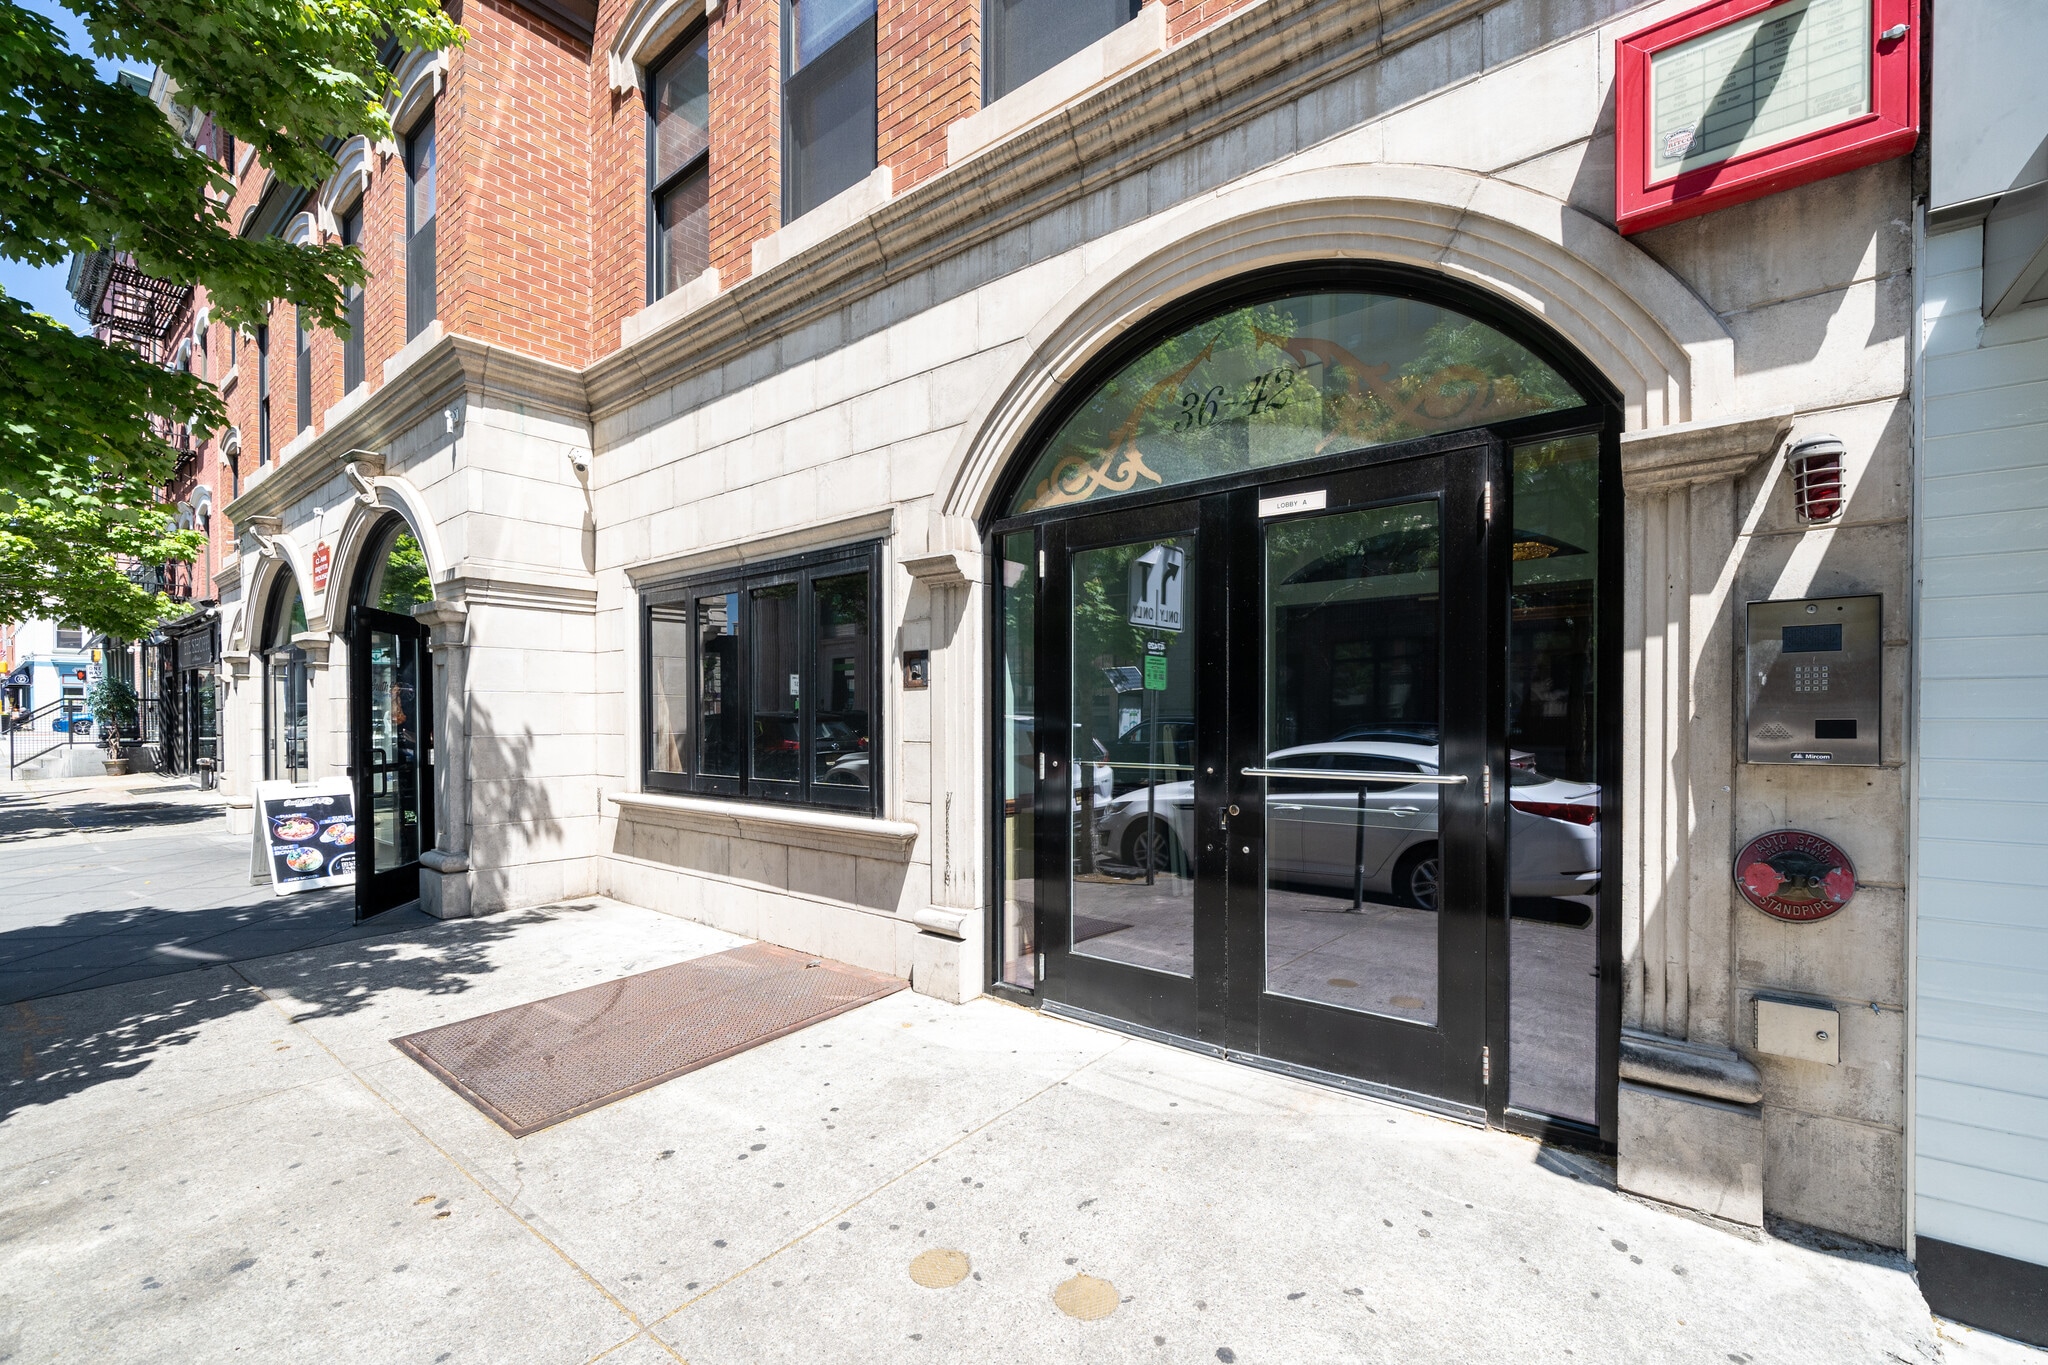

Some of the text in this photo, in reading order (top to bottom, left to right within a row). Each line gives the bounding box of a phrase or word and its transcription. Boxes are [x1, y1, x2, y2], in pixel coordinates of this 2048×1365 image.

[1173, 366, 1295, 433] 36-42
[1276, 501, 1298, 509] LOBBY
[1755, 834, 1834, 858] AUTO SPKR.
[1759, 896, 1834, 917] STANDPIPE
